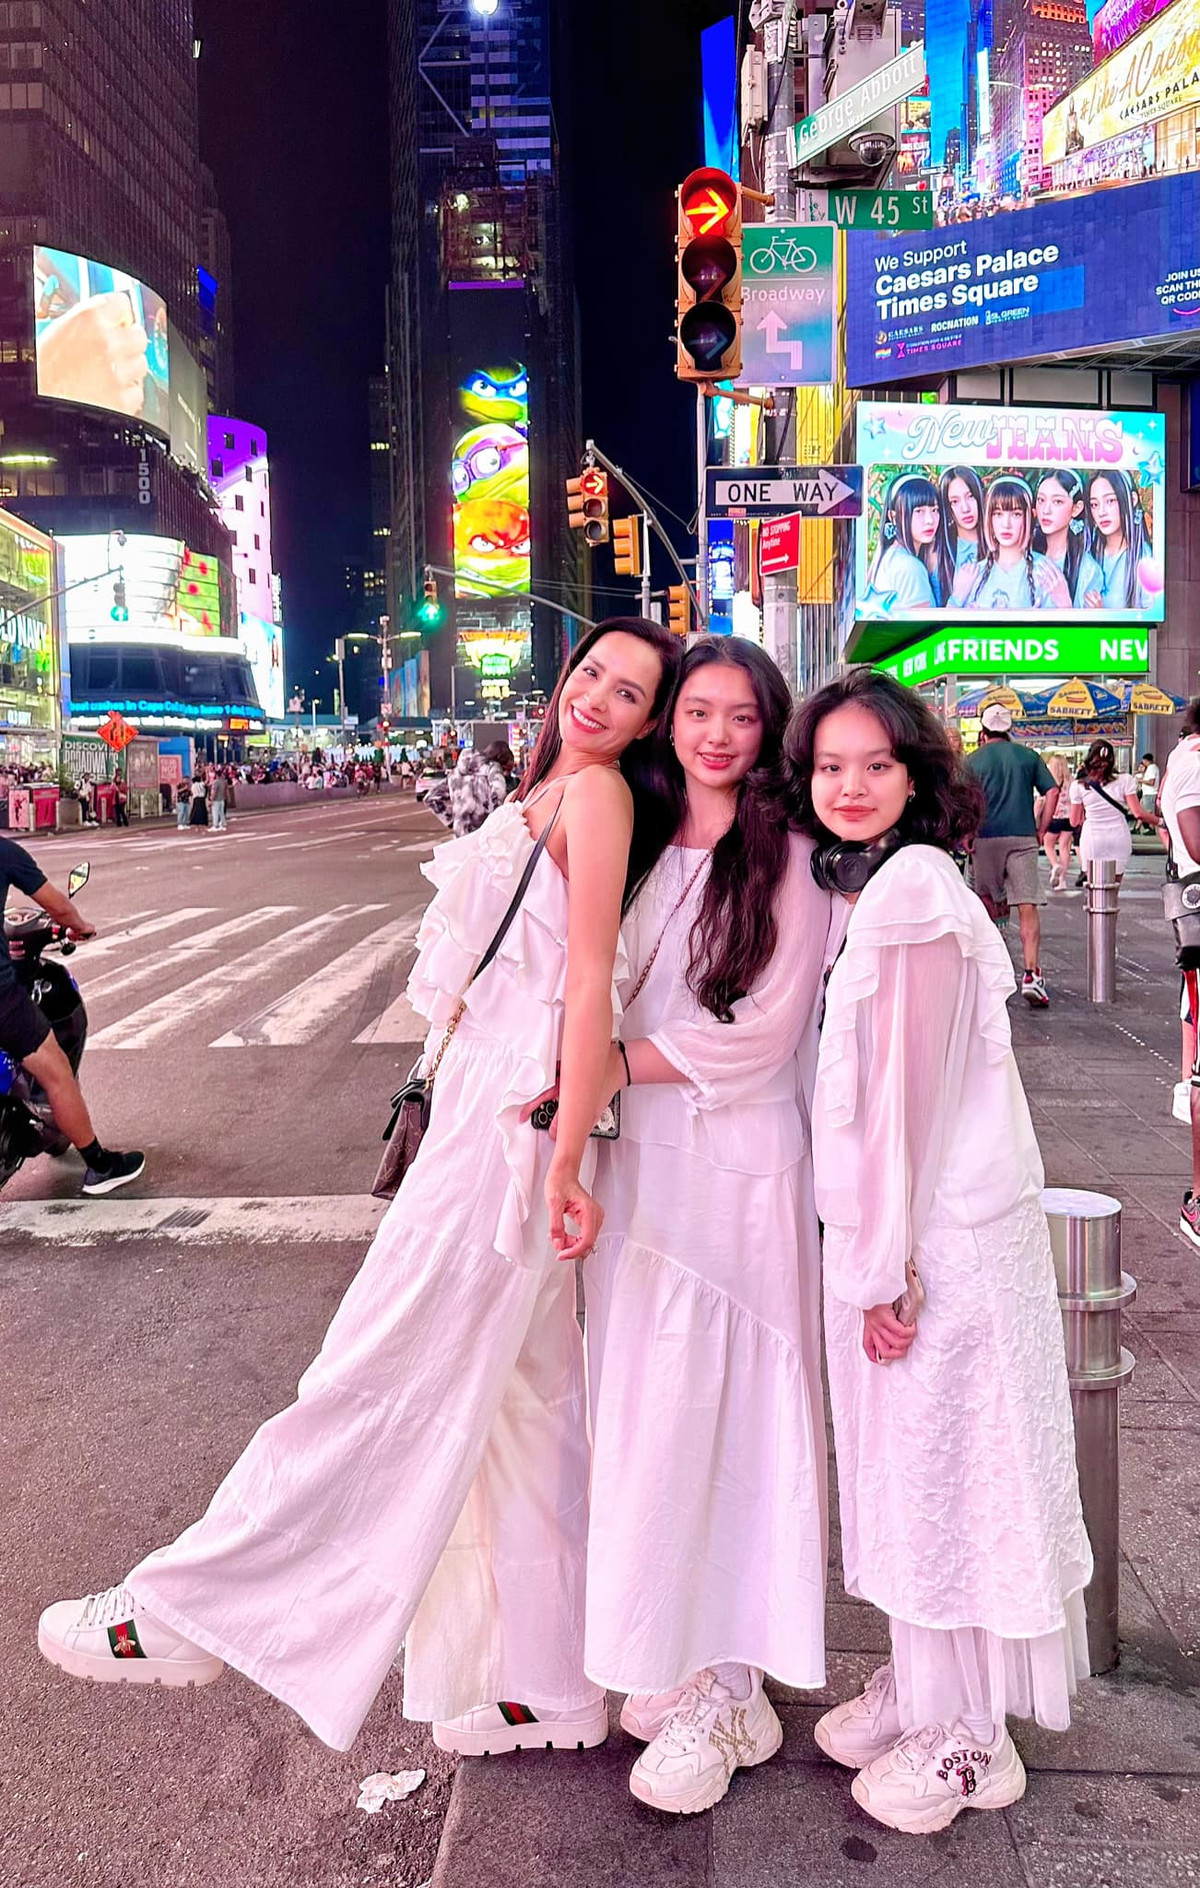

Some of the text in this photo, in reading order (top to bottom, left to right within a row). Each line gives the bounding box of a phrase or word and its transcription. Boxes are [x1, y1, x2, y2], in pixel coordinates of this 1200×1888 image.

[800, 54, 919, 145] George Abbott
[1119, 92, 1160, 120] CAESARS
[847, 112, 865, 127] Way
[834, 195, 928, 225] W 45 St
[874, 240, 967, 273] We Support
[875, 244, 1059, 297] Caesars Palace
[1165, 270, 1189, 283] JOIN
[741, 285, 826, 304] Broadway
[1156, 279, 1200, 295] SCAN TH
[876, 274, 1039, 321] Times Square
[1161, 290, 1200, 305] QR COD
[906, 345, 929, 355] TIMES
[931, 339, 963, 352] SQUARE
[138, 447, 151, 505] 1500
[727, 482, 839, 502] ONE WAY
[762, 520, 791, 538] NO STOPPING
[762, 537, 781, 550] Anytime
[0, 606, 48, 651] LD NAVY
[948, 638, 1059, 661] FRIENDS
[1050, 706, 1093, 716] SABRETT
[1133, 702, 1171, 712] SABRETT
[936, 1748, 992, 1781] BOSTON
